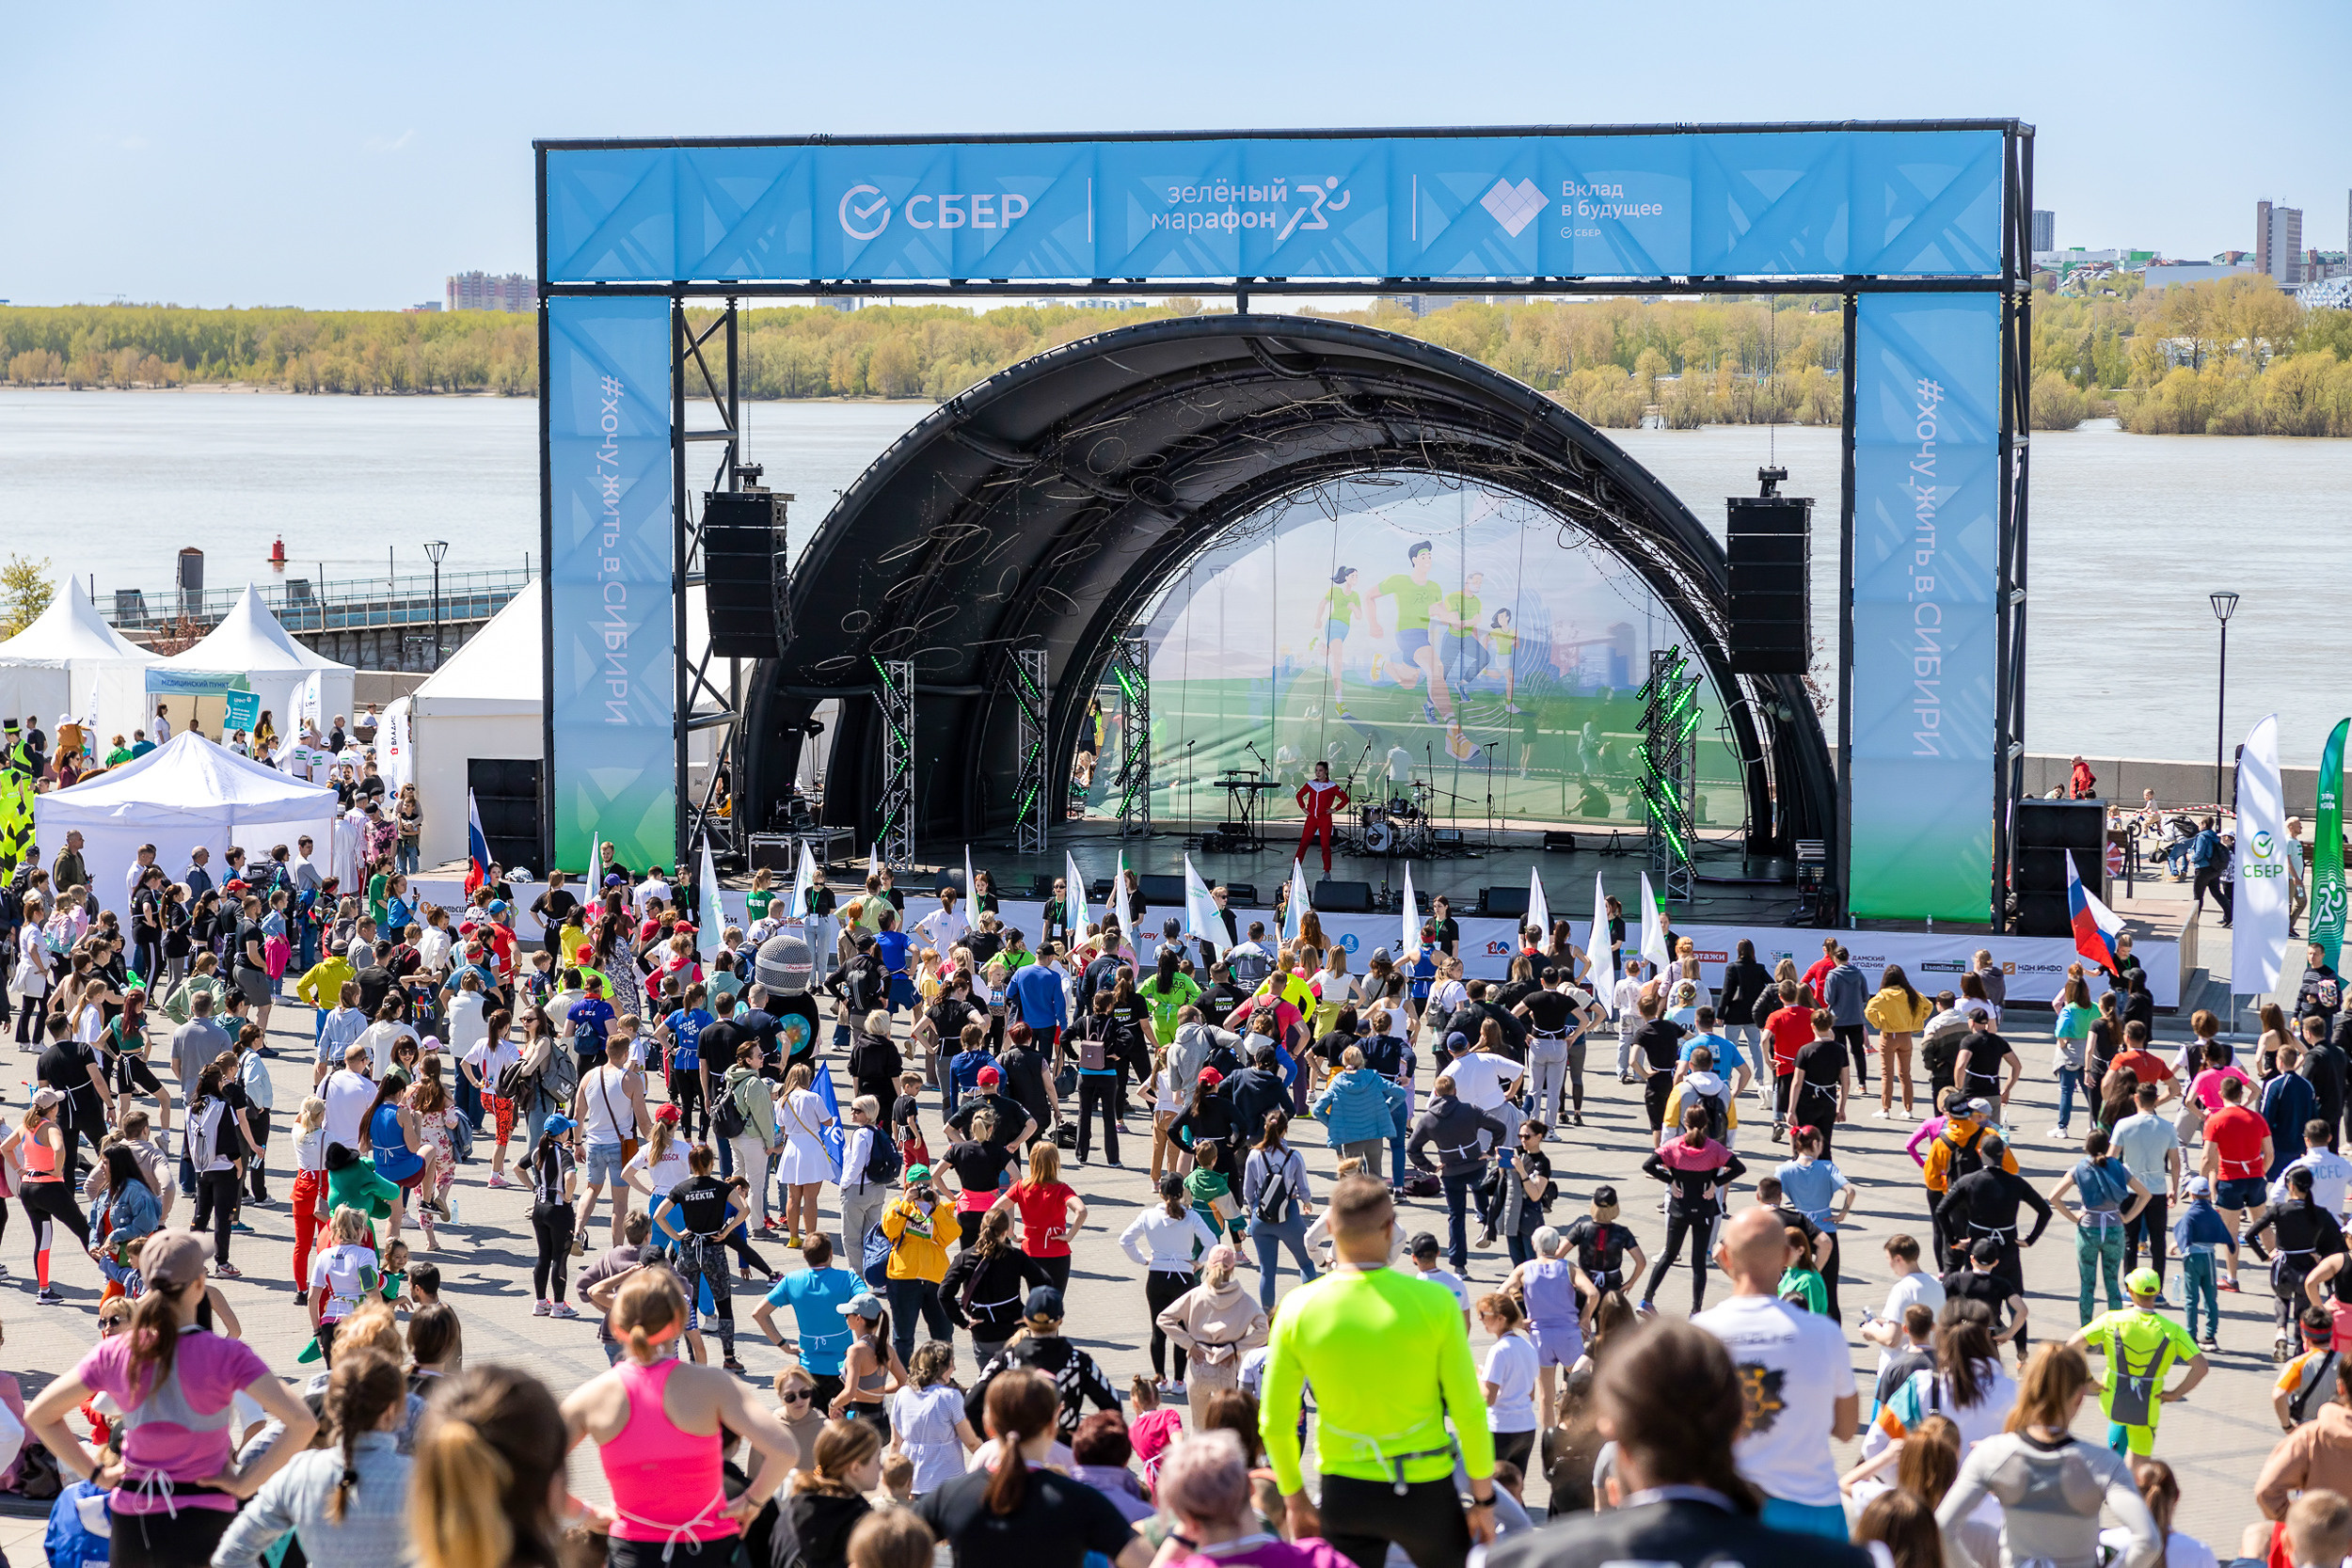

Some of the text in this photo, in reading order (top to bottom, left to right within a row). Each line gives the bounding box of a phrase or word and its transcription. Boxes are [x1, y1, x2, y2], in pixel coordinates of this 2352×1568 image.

[1168, 177, 1288, 204] зелёный
[1562, 181, 1624, 199] Вклад
[905, 194, 1029, 230] СБЕР
[1562, 198, 1663, 220] в будущее
[1152, 207, 1277, 235] марафон
[1575, 228, 1601, 237] СБЕР
[161, 679, 208, 689] МЕДИЦИНСКИЙ
[2242, 864, 2284, 879] СБЕР
[1924, 963, 1964, 972] ksonline.ru
